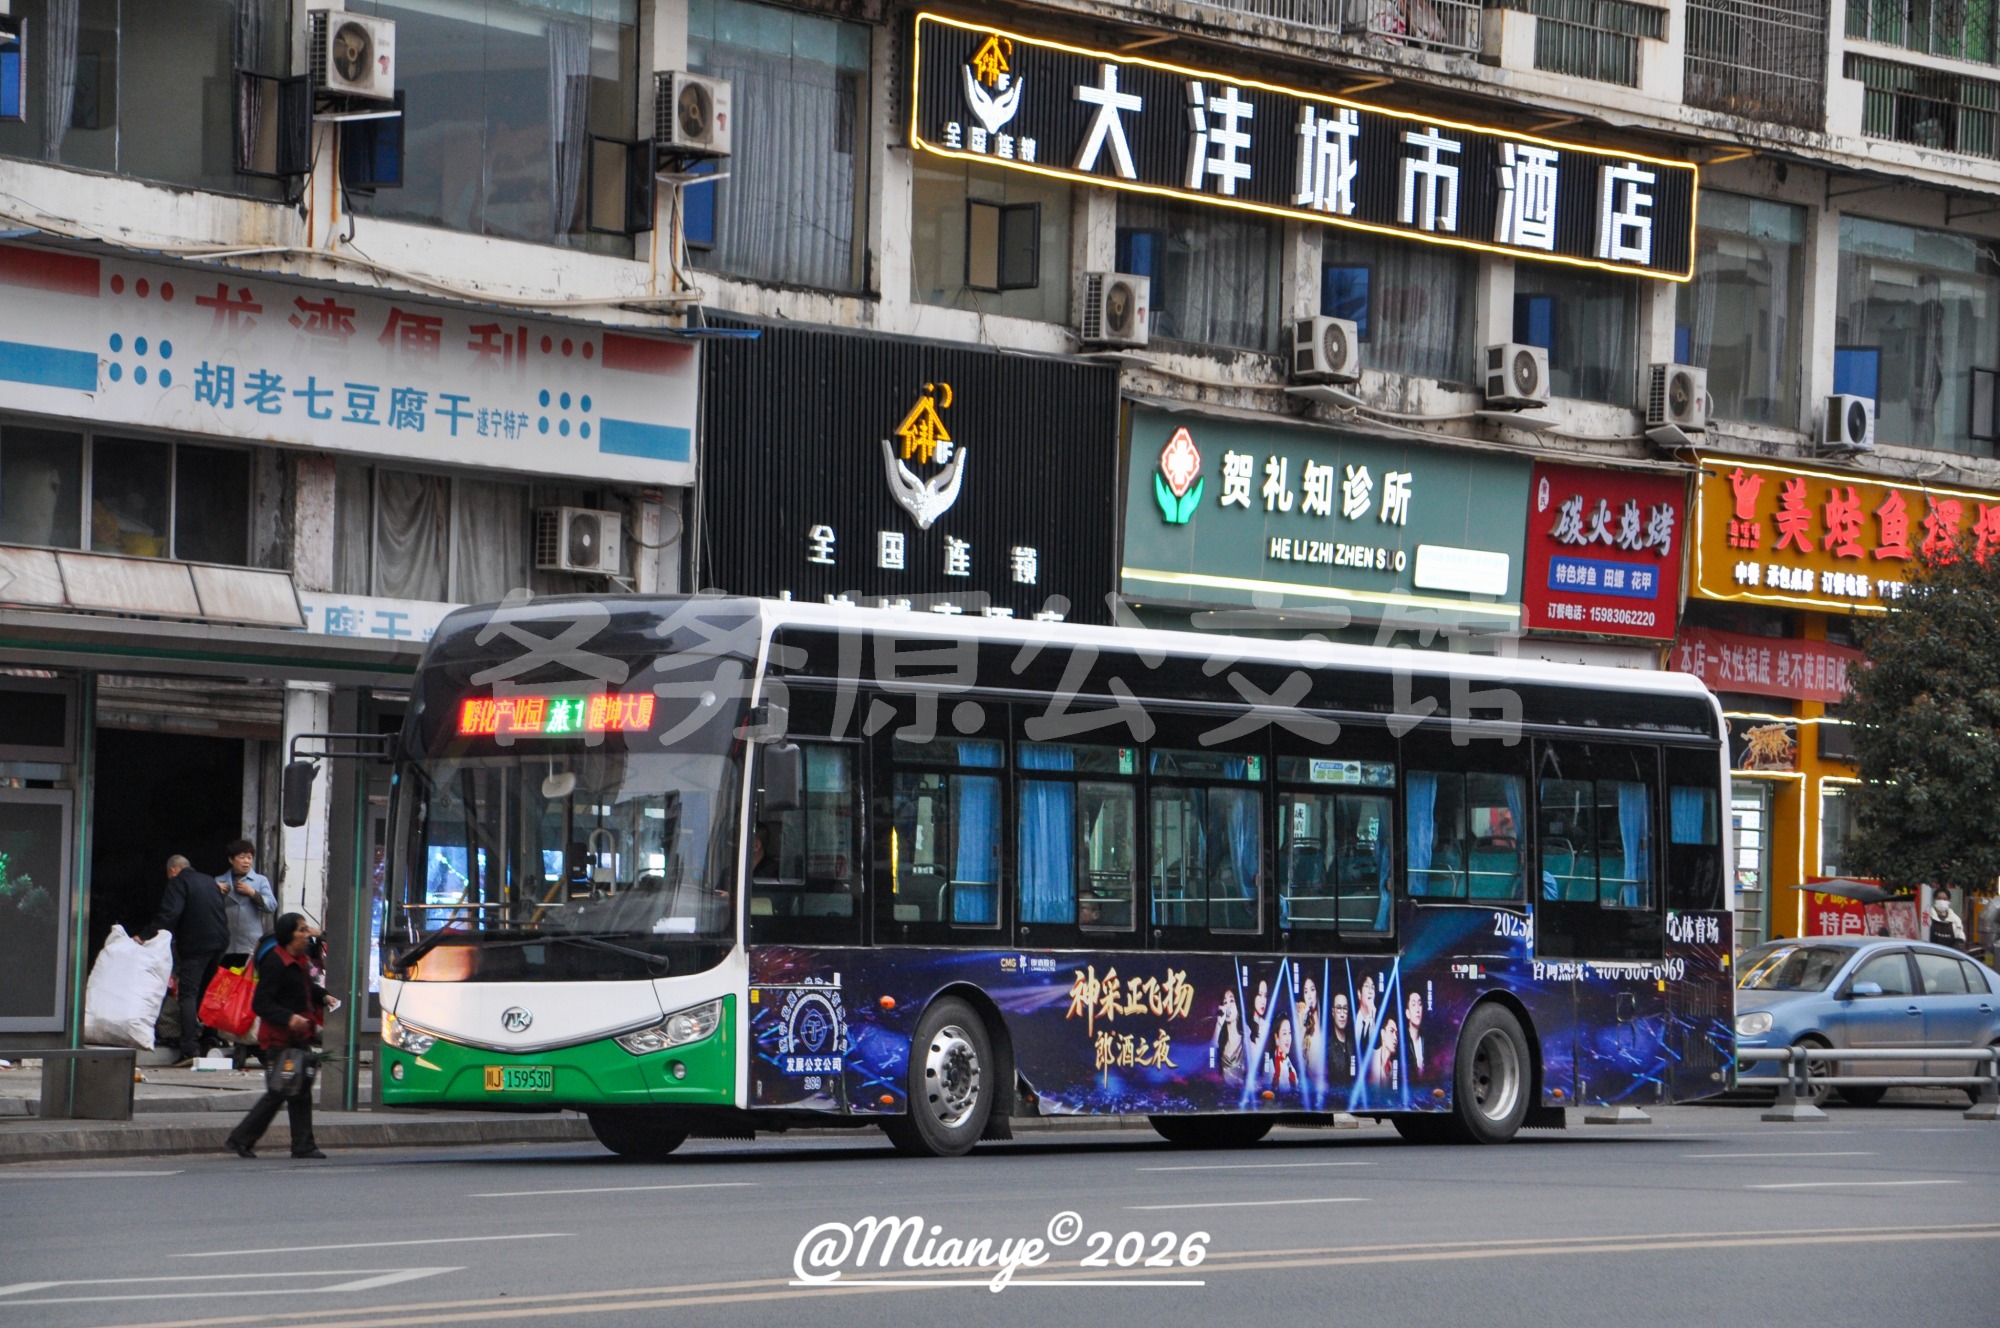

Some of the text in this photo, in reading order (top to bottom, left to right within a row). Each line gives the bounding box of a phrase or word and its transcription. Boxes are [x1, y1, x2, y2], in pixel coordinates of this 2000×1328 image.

[195, 283, 527, 380] 龙湾便利
[194, 361, 528, 440] 胡老七豆腐干 遂宁特产
[1221, 450, 1412, 526] 贺礼知诊所
[808, 525, 1037, 584] 全国连锁
[1271, 537, 1291, 560] HE
[1308, 541, 1333, 564] ZHI
[1335, 543, 1374, 568] ZHEN
[1552, 494, 1675, 557] 碳火烧烤
[1556, 563, 1652, 591] 特色烤鱼 田螺 花甲
[1680, 639, 1858, 693] 本店一次性锅底 绝不使用回收
[461, 700, 545, 734] 孵化产业园
[588, 693, 656, 730] 健坤大厦
[1066, 964, 1194, 1038] 神采正飞扬
[786, 1057, 842, 1072] 发展公交公司
[1094, 1028, 1178, 1089] 郎酒之夜
